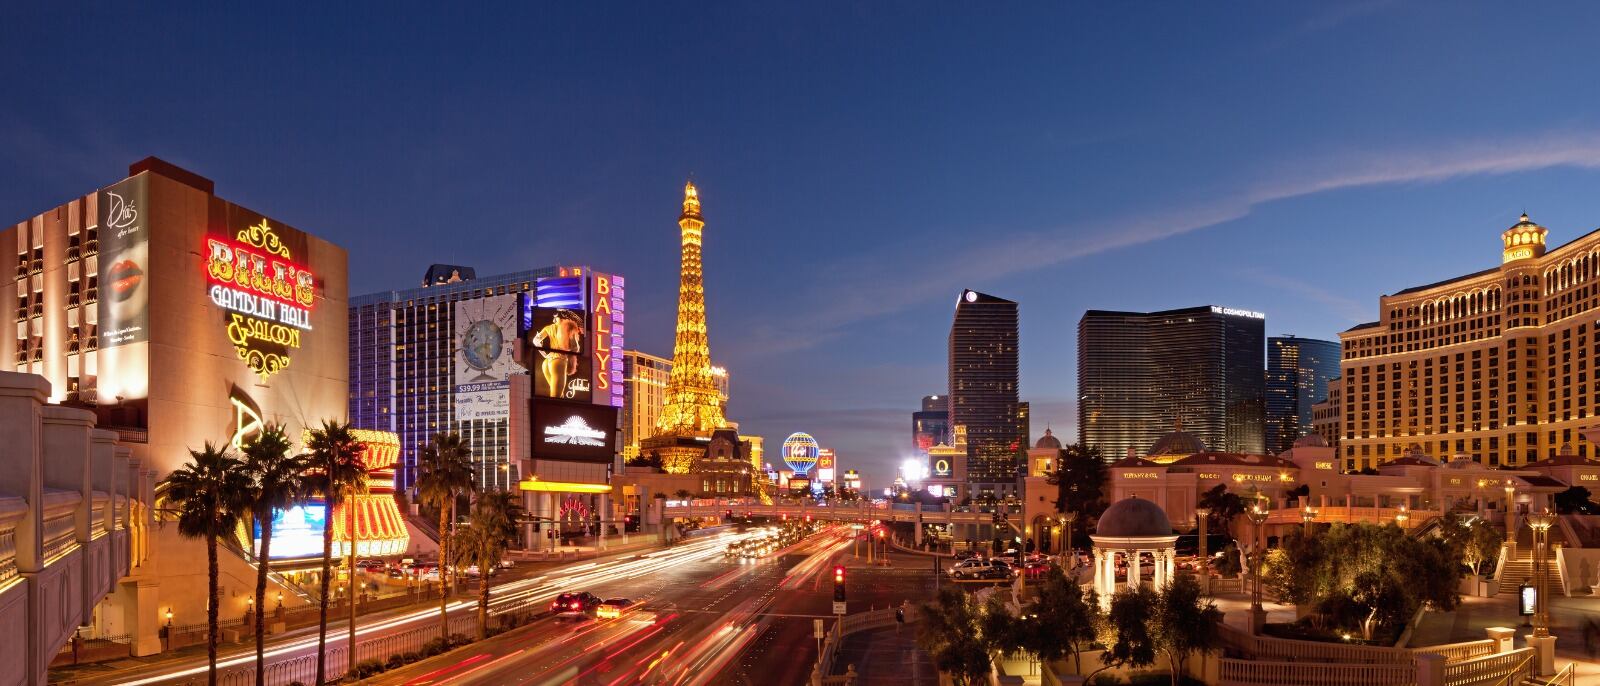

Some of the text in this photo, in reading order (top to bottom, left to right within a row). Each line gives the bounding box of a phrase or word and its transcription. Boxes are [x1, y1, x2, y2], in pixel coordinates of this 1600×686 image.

[208, 239, 314, 307] BILL'S
[211, 285, 312, 330] GAMBLIN' HALL
[1223, 308, 1265, 319] COSMOPOLITAN
[247, 318, 300, 348] SALOON
[460, 384, 481, 392] $39.99
